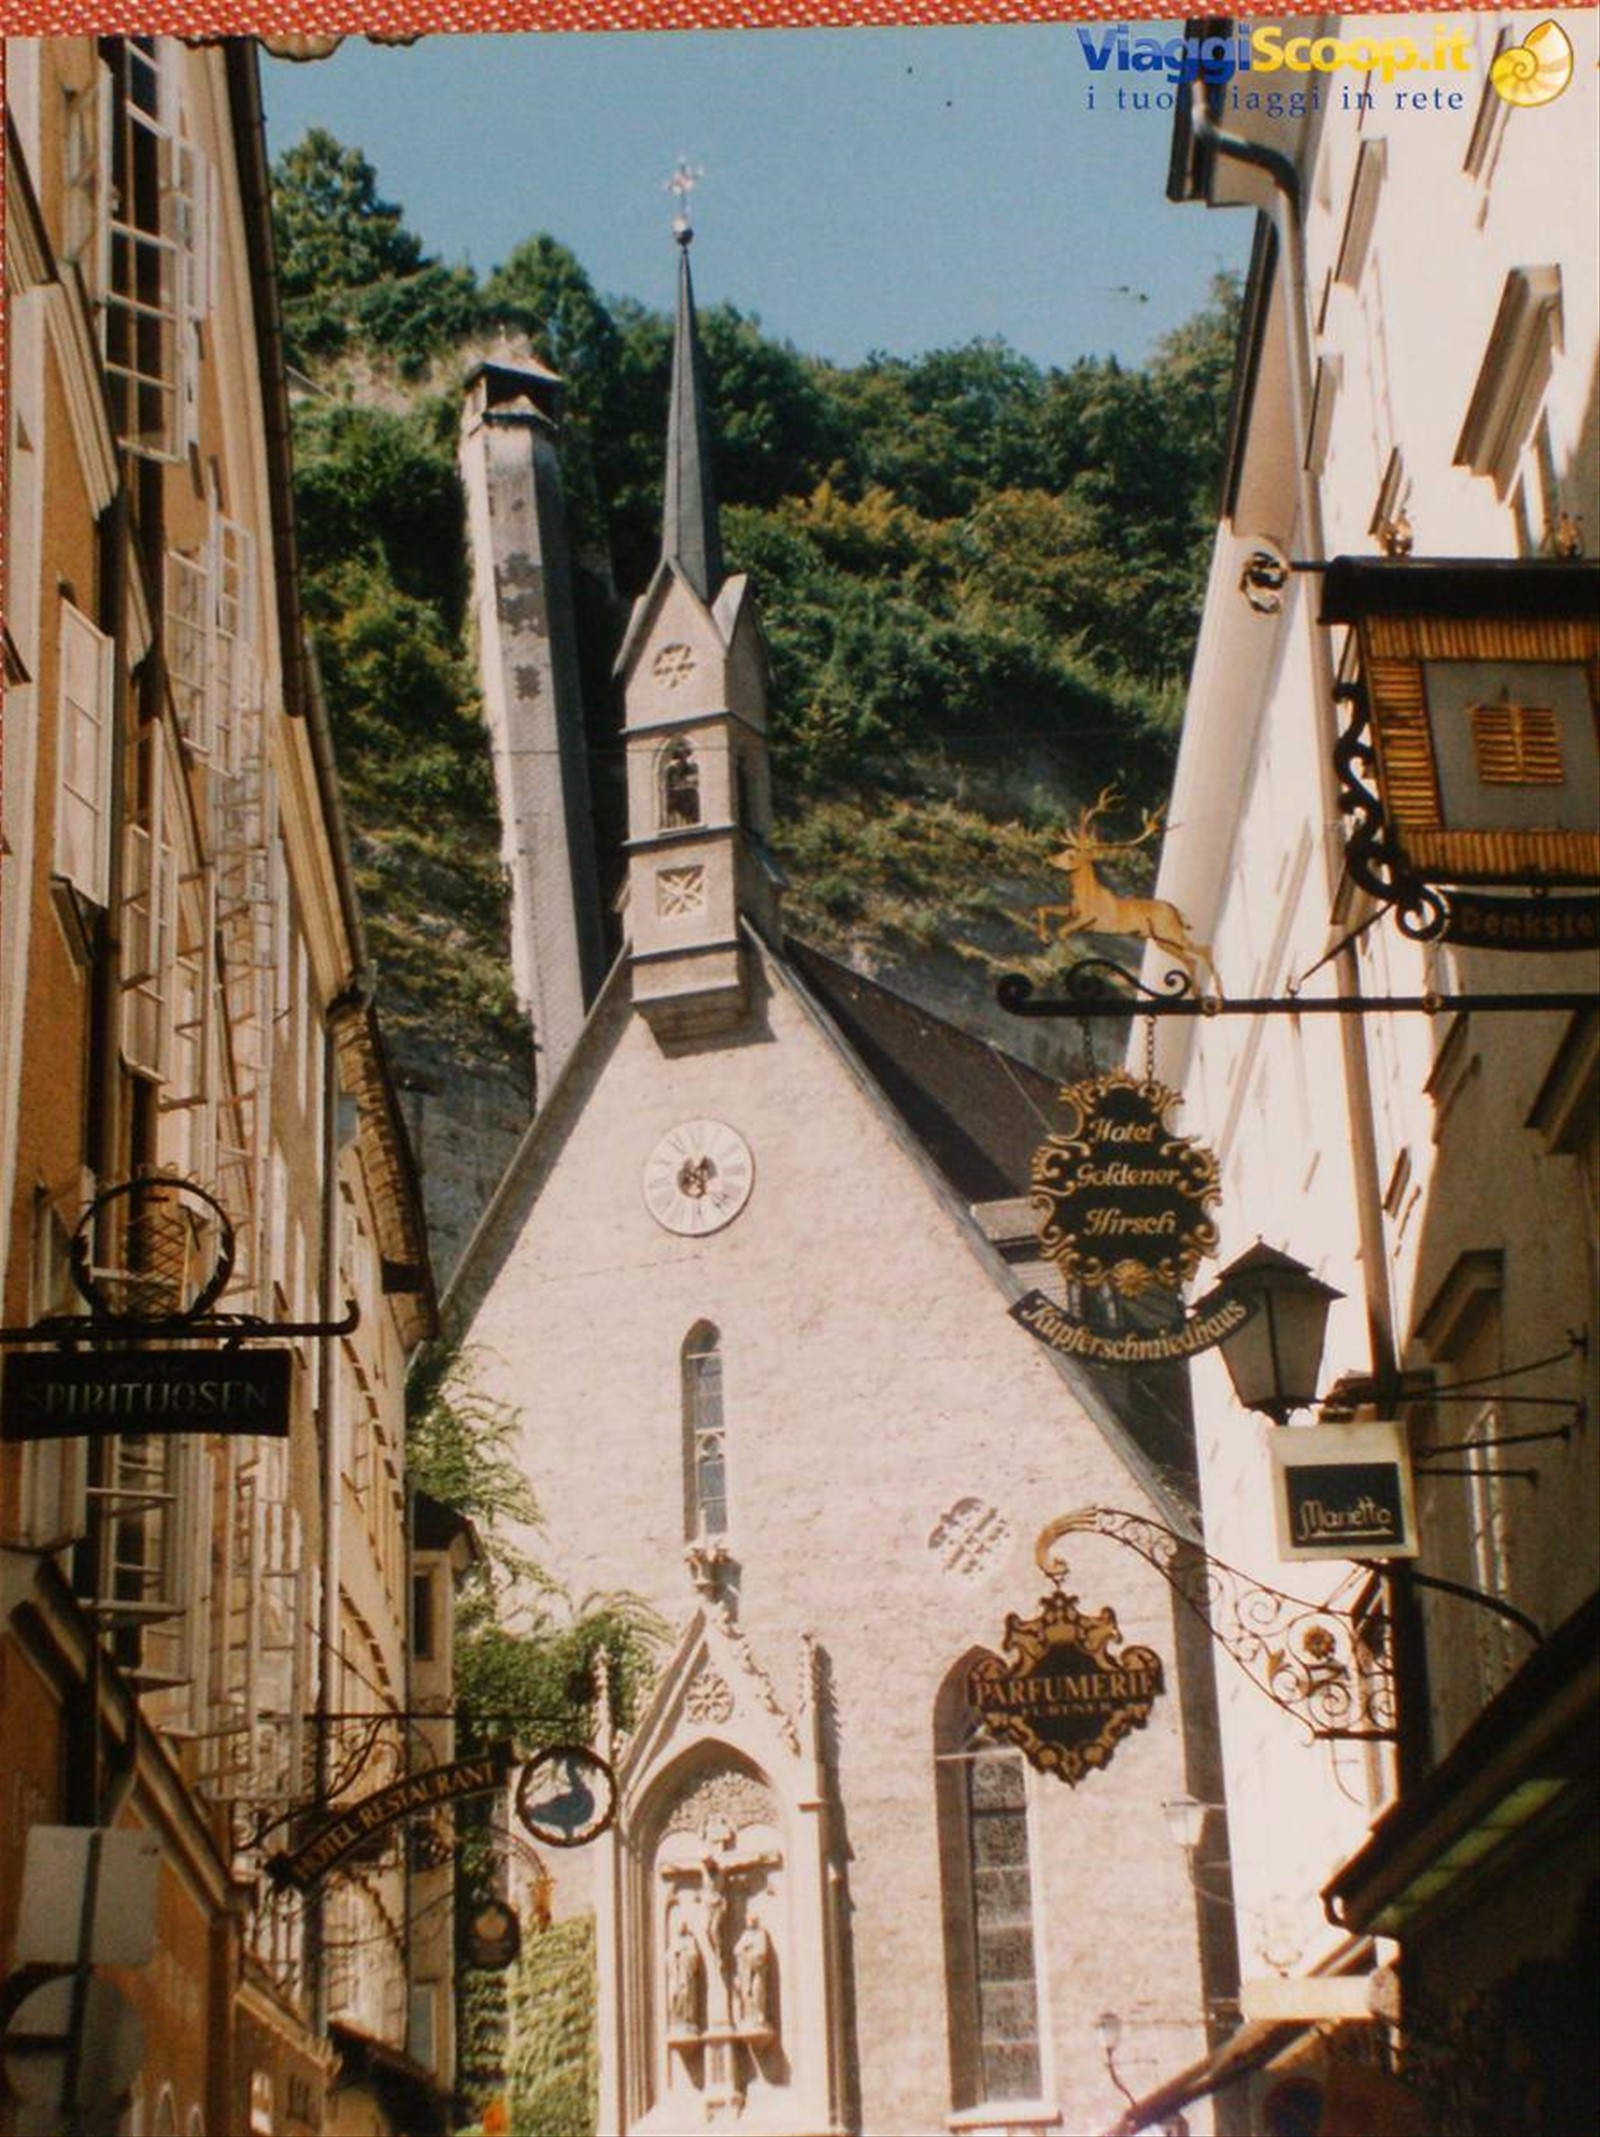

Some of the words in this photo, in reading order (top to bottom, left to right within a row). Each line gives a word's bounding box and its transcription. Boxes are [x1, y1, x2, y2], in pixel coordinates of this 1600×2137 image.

[1088, 1119, 1158, 1143] Hotel
[1076, 1162, 1181, 1187] Goldener
[1083, 1208, 1178, 1236] Hirsch
[1021, 1298, 1248, 1360] Kupferschmiedhaus
[26, 1380, 270, 1415] SPIRITUOSEN
[975, 1673, 1153, 1706] PARFUMERIE
[292, 1821, 361, 1881] HOTEL
[359, 1761, 496, 1830] RESTAURANT
